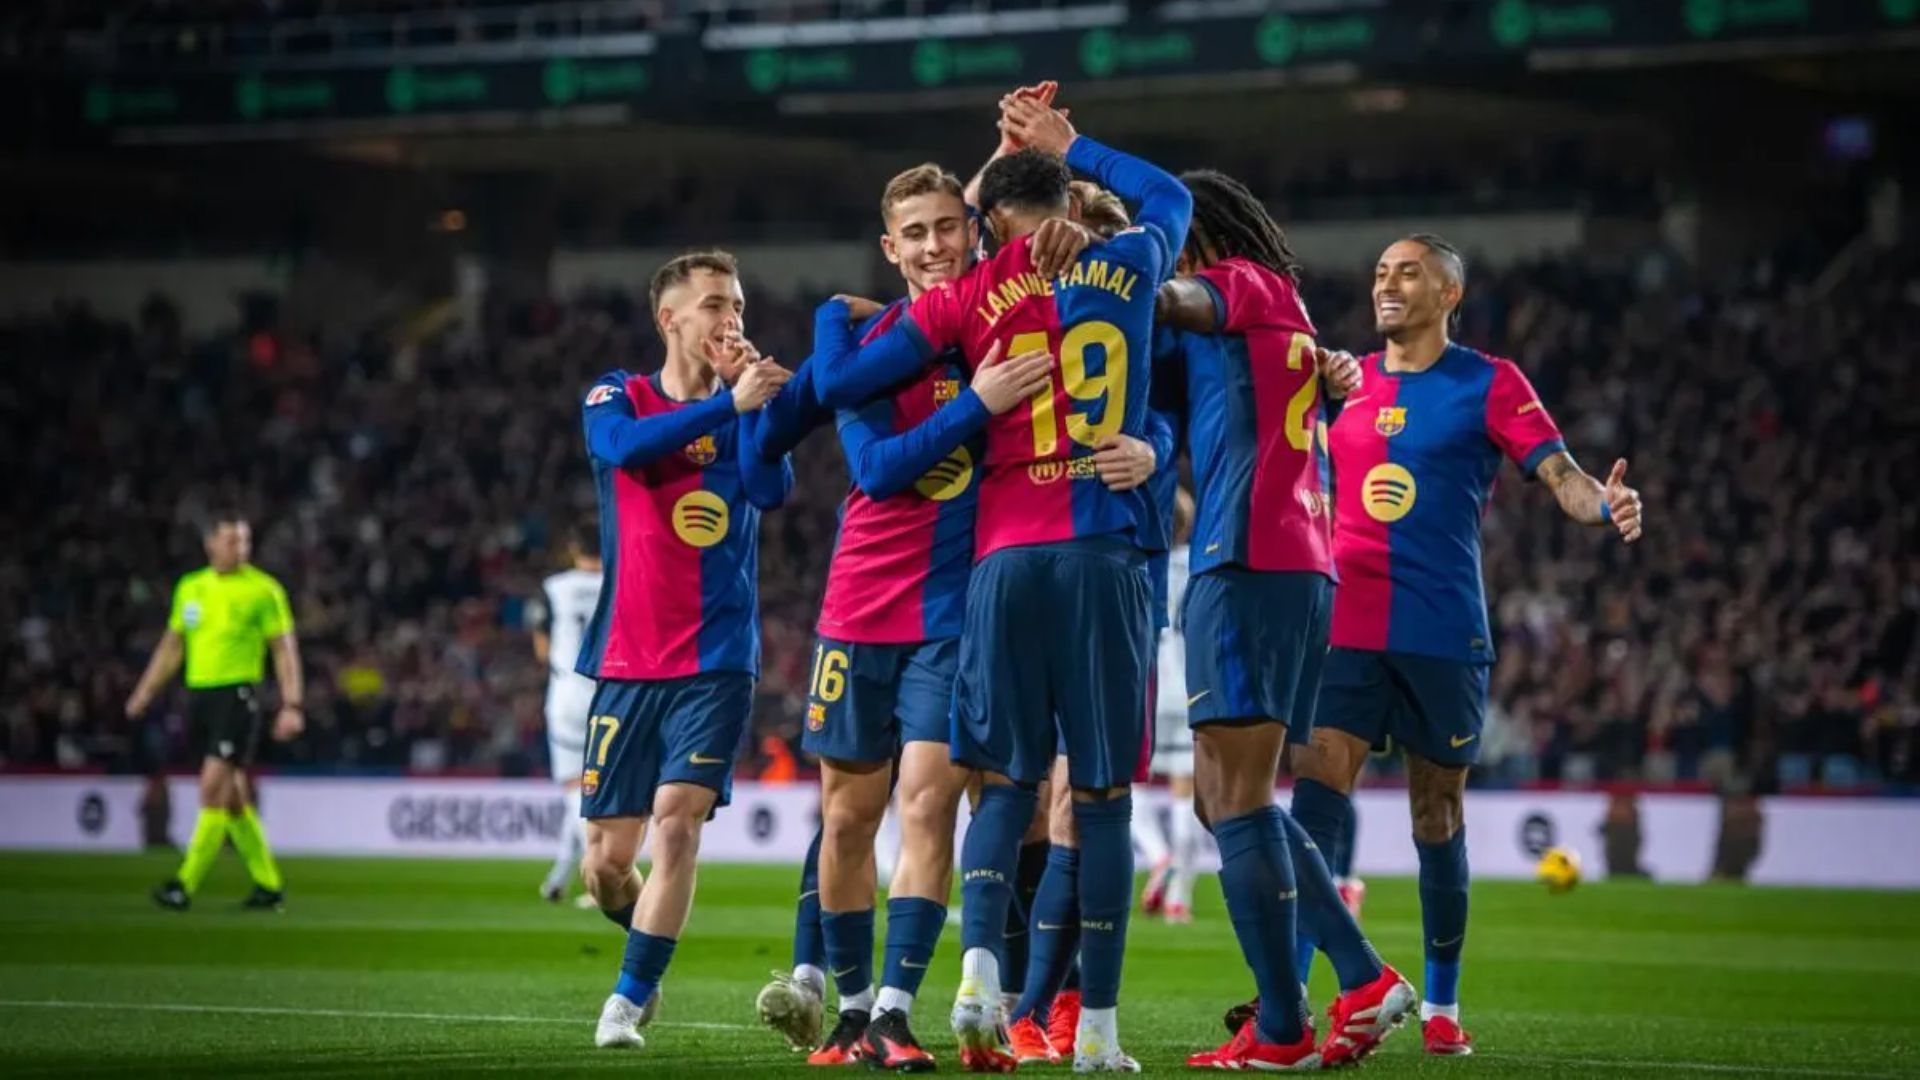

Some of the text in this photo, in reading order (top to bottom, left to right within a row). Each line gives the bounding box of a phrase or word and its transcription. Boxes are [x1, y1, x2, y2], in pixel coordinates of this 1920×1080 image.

[977, 272, 1055, 327] LAMINE
[1006, 321, 1128, 456] 19
[1285, 331, 1328, 455] 2
[810, 643, 848, 702] 16
[586, 715, 620, 766] 17
